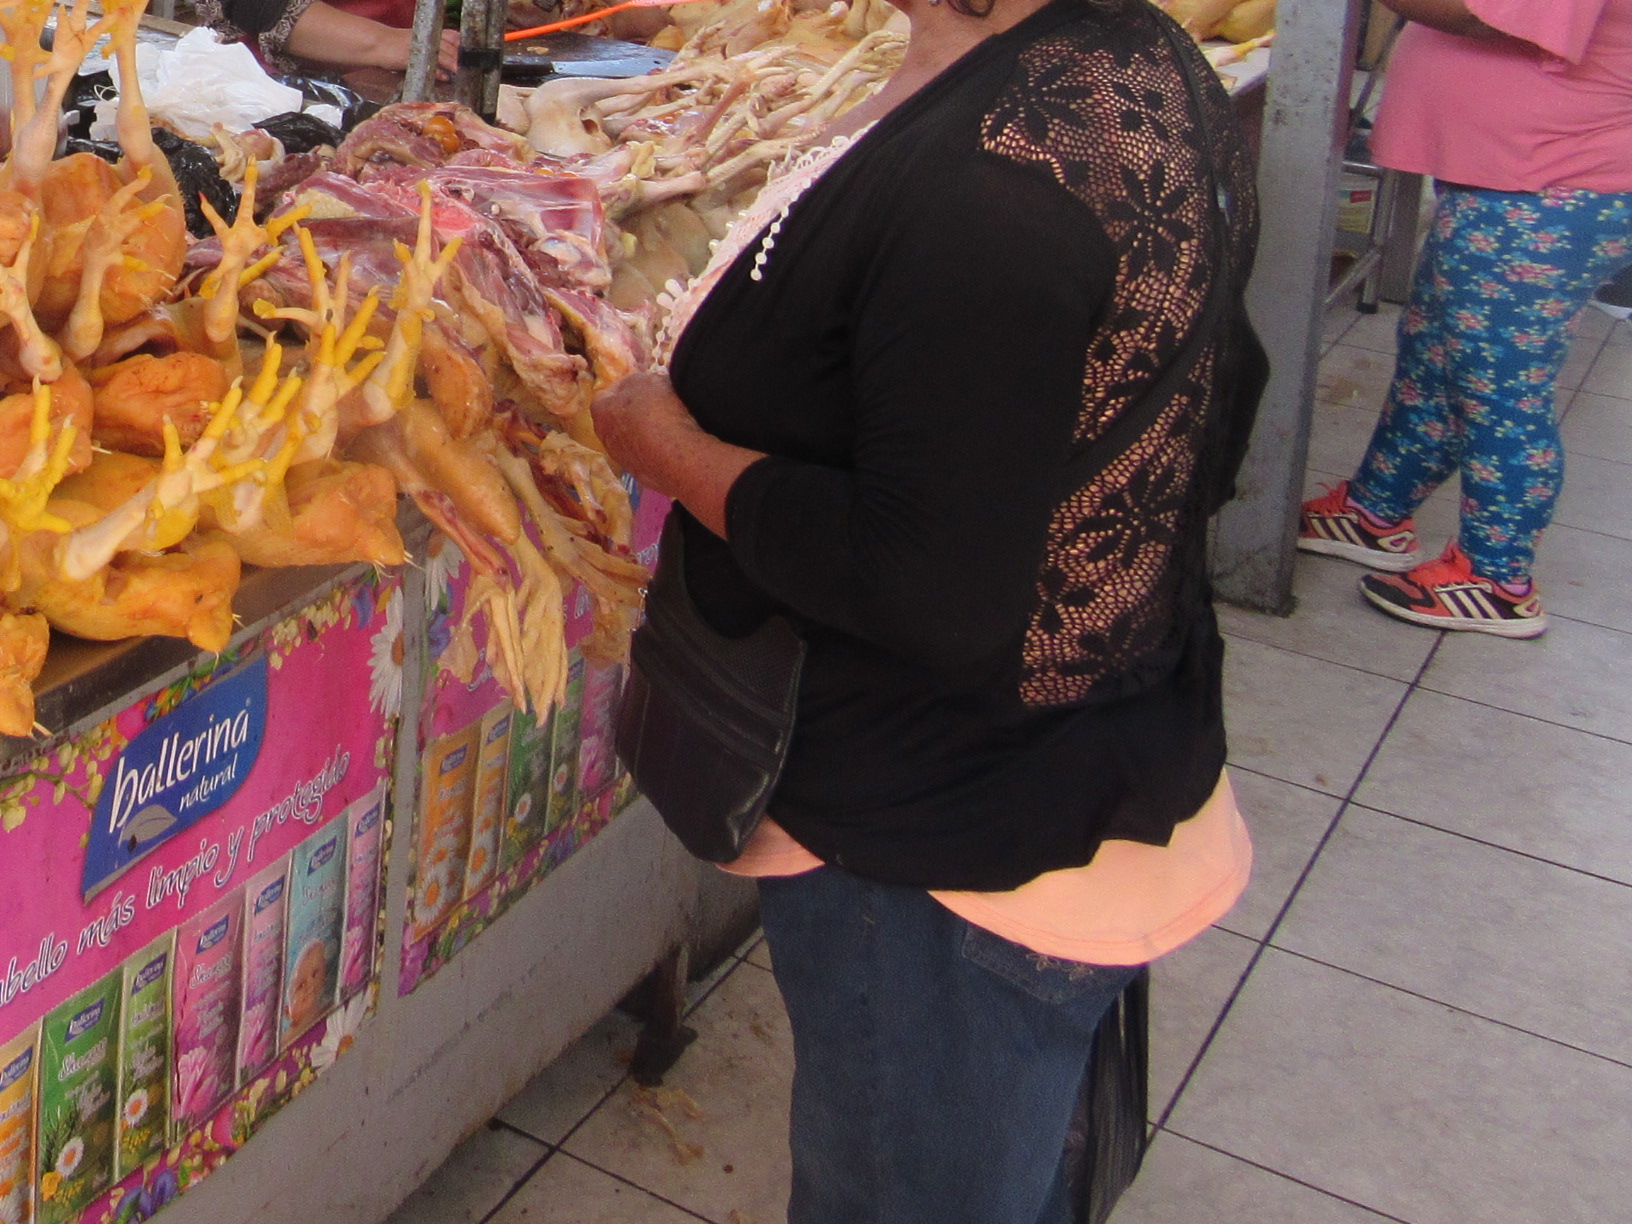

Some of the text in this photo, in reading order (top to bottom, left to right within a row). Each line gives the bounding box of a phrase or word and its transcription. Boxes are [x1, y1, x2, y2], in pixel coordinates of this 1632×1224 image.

[108, 706, 251, 834] ballerina
[178, 753, 237, 812] natural
[76, 891, 135, 956] más
[145, 837, 221, 909] limpio
[213, 826, 245, 889] y
[246, 744, 351, 862] protegido
